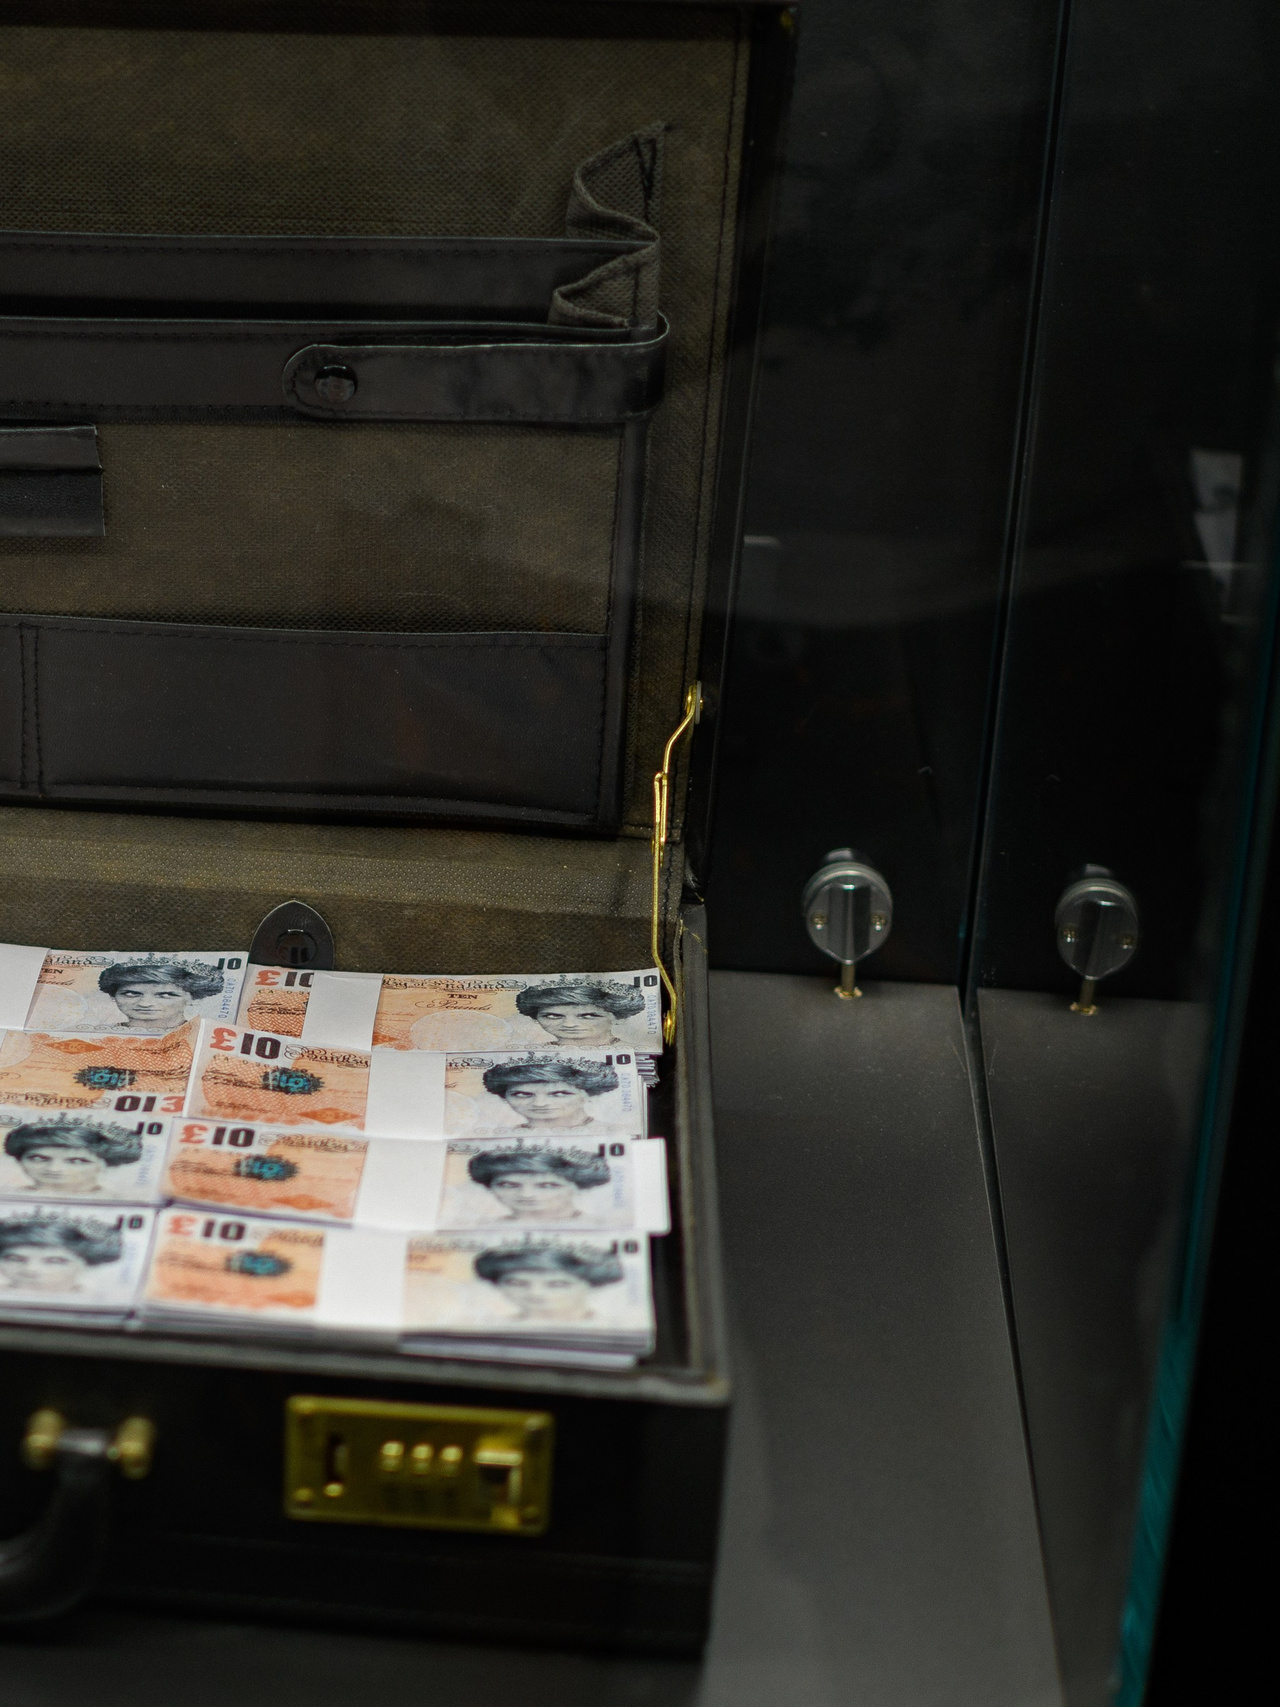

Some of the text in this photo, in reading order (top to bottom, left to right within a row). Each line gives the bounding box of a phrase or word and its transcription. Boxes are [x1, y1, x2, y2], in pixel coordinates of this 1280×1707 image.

[217, 957, 242, 970] 10
[634, 975, 658, 988] 10
[209, 1027, 281, 1059] £10
[606, 1054, 630, 1065] 10
[136, 1121, 163, 1135] 10
[179, 1123, 255, 1147] £10
[598, 1143, 625, 1157] 10
[115, 1214, 143, 1229] 10
[168, 1215, 245, 1241] £10
